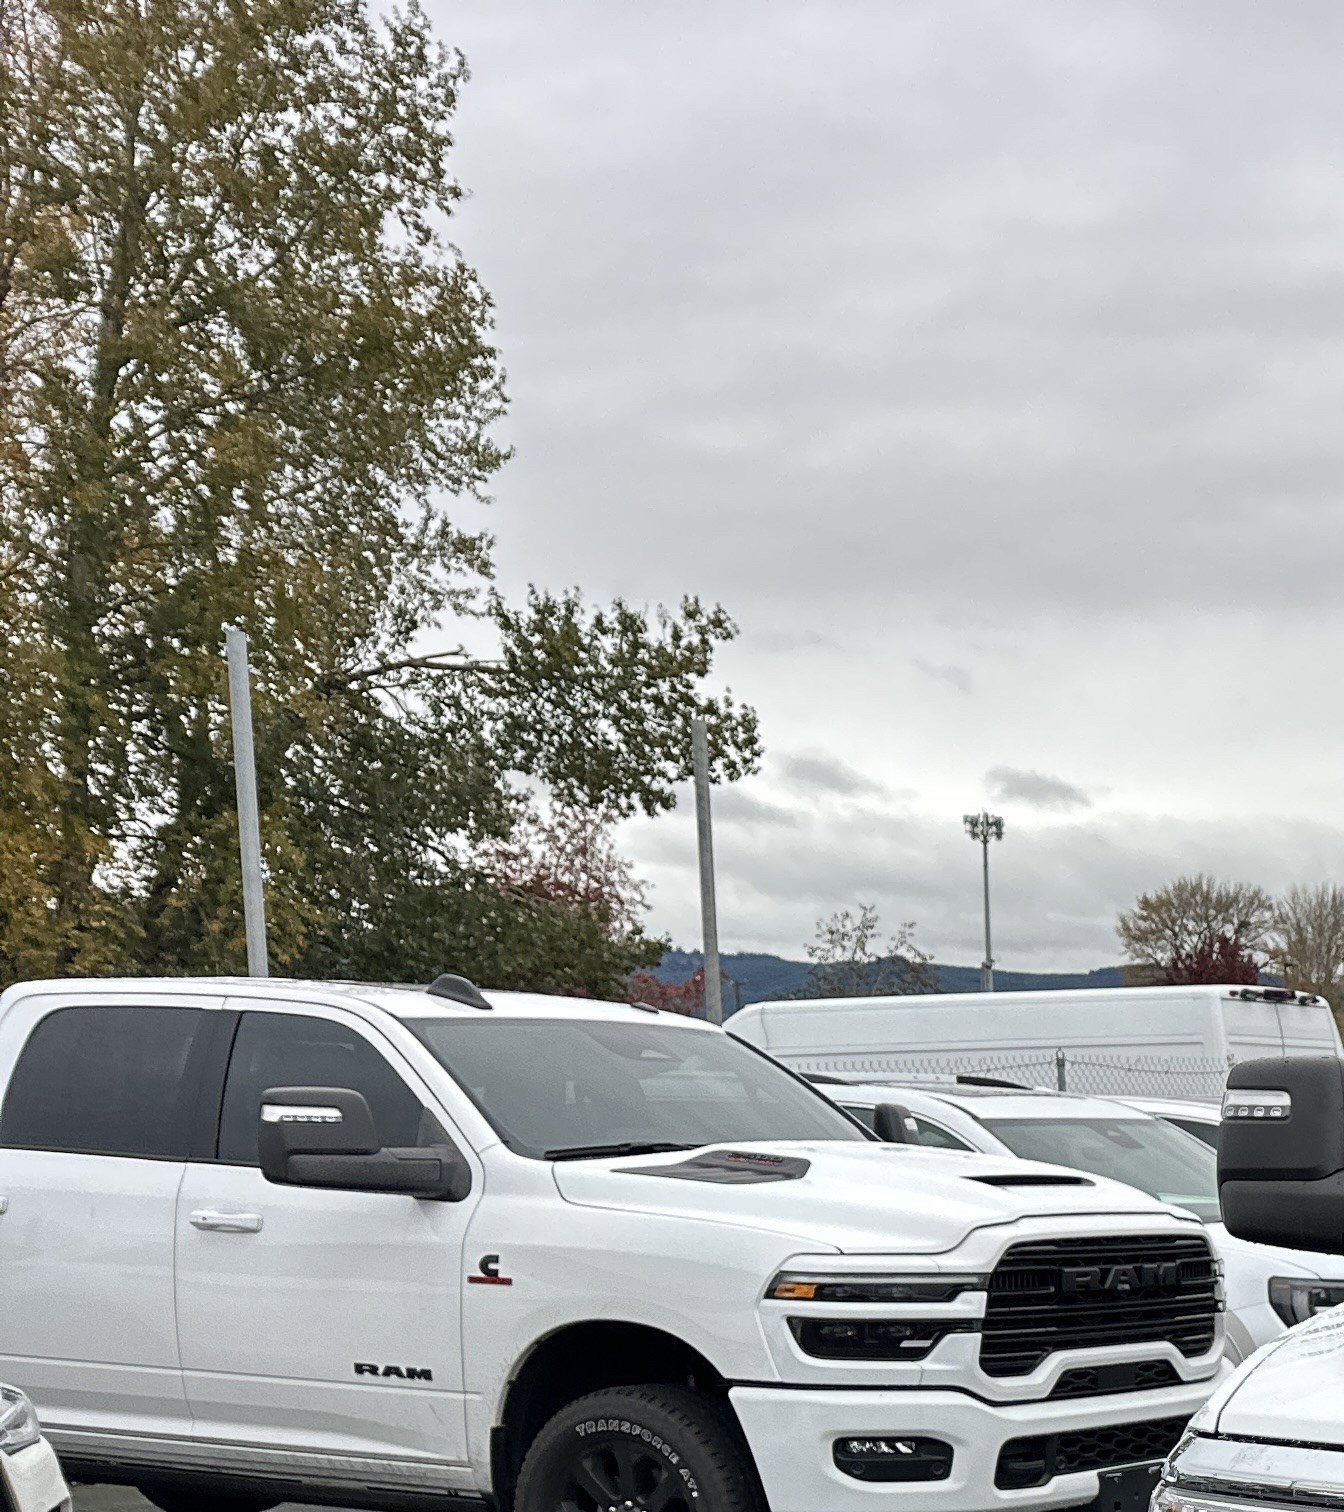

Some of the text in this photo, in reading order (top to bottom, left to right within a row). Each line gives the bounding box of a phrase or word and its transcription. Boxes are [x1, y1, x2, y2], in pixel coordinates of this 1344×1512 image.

[1062, 1262, 1177, 1291] RAM
[353, 1362, 433, 1381] RAM
[575, 1419, 680, 1465] TRANSFORCE
